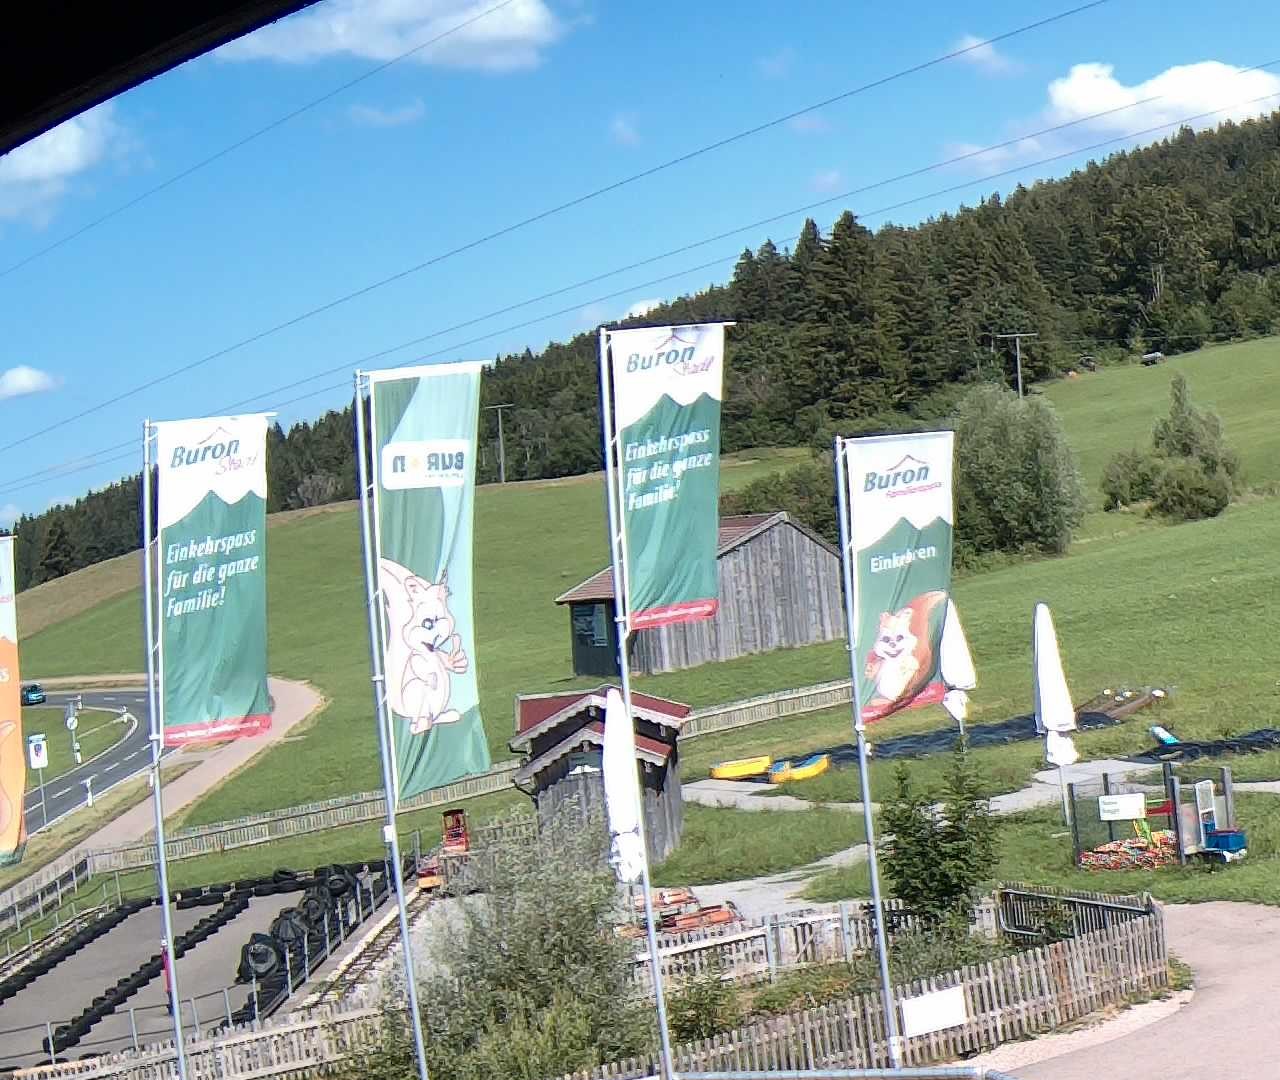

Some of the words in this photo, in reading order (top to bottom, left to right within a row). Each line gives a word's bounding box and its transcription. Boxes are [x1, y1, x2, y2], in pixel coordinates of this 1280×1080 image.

[627, 346, 695, 373] Buron
[170, 439, 239, 469] Buron
[625, 429, 710, 462] Einkehrspass
[627, 467, 648, 491] für
[650, 462, 670, 481] die
[672, 451, 713, 478] ganze
[863, 466, 930, 492] Buron
[166, 529, 257, 565] Einkehrspass
[870, 545, 937, 573] Einkehren
[164, 568, 189, 597] für
[192, 563, 220, 585] die
[218, 555, 260, 584] ganze
[166, 586, 226, 618] Familie!
